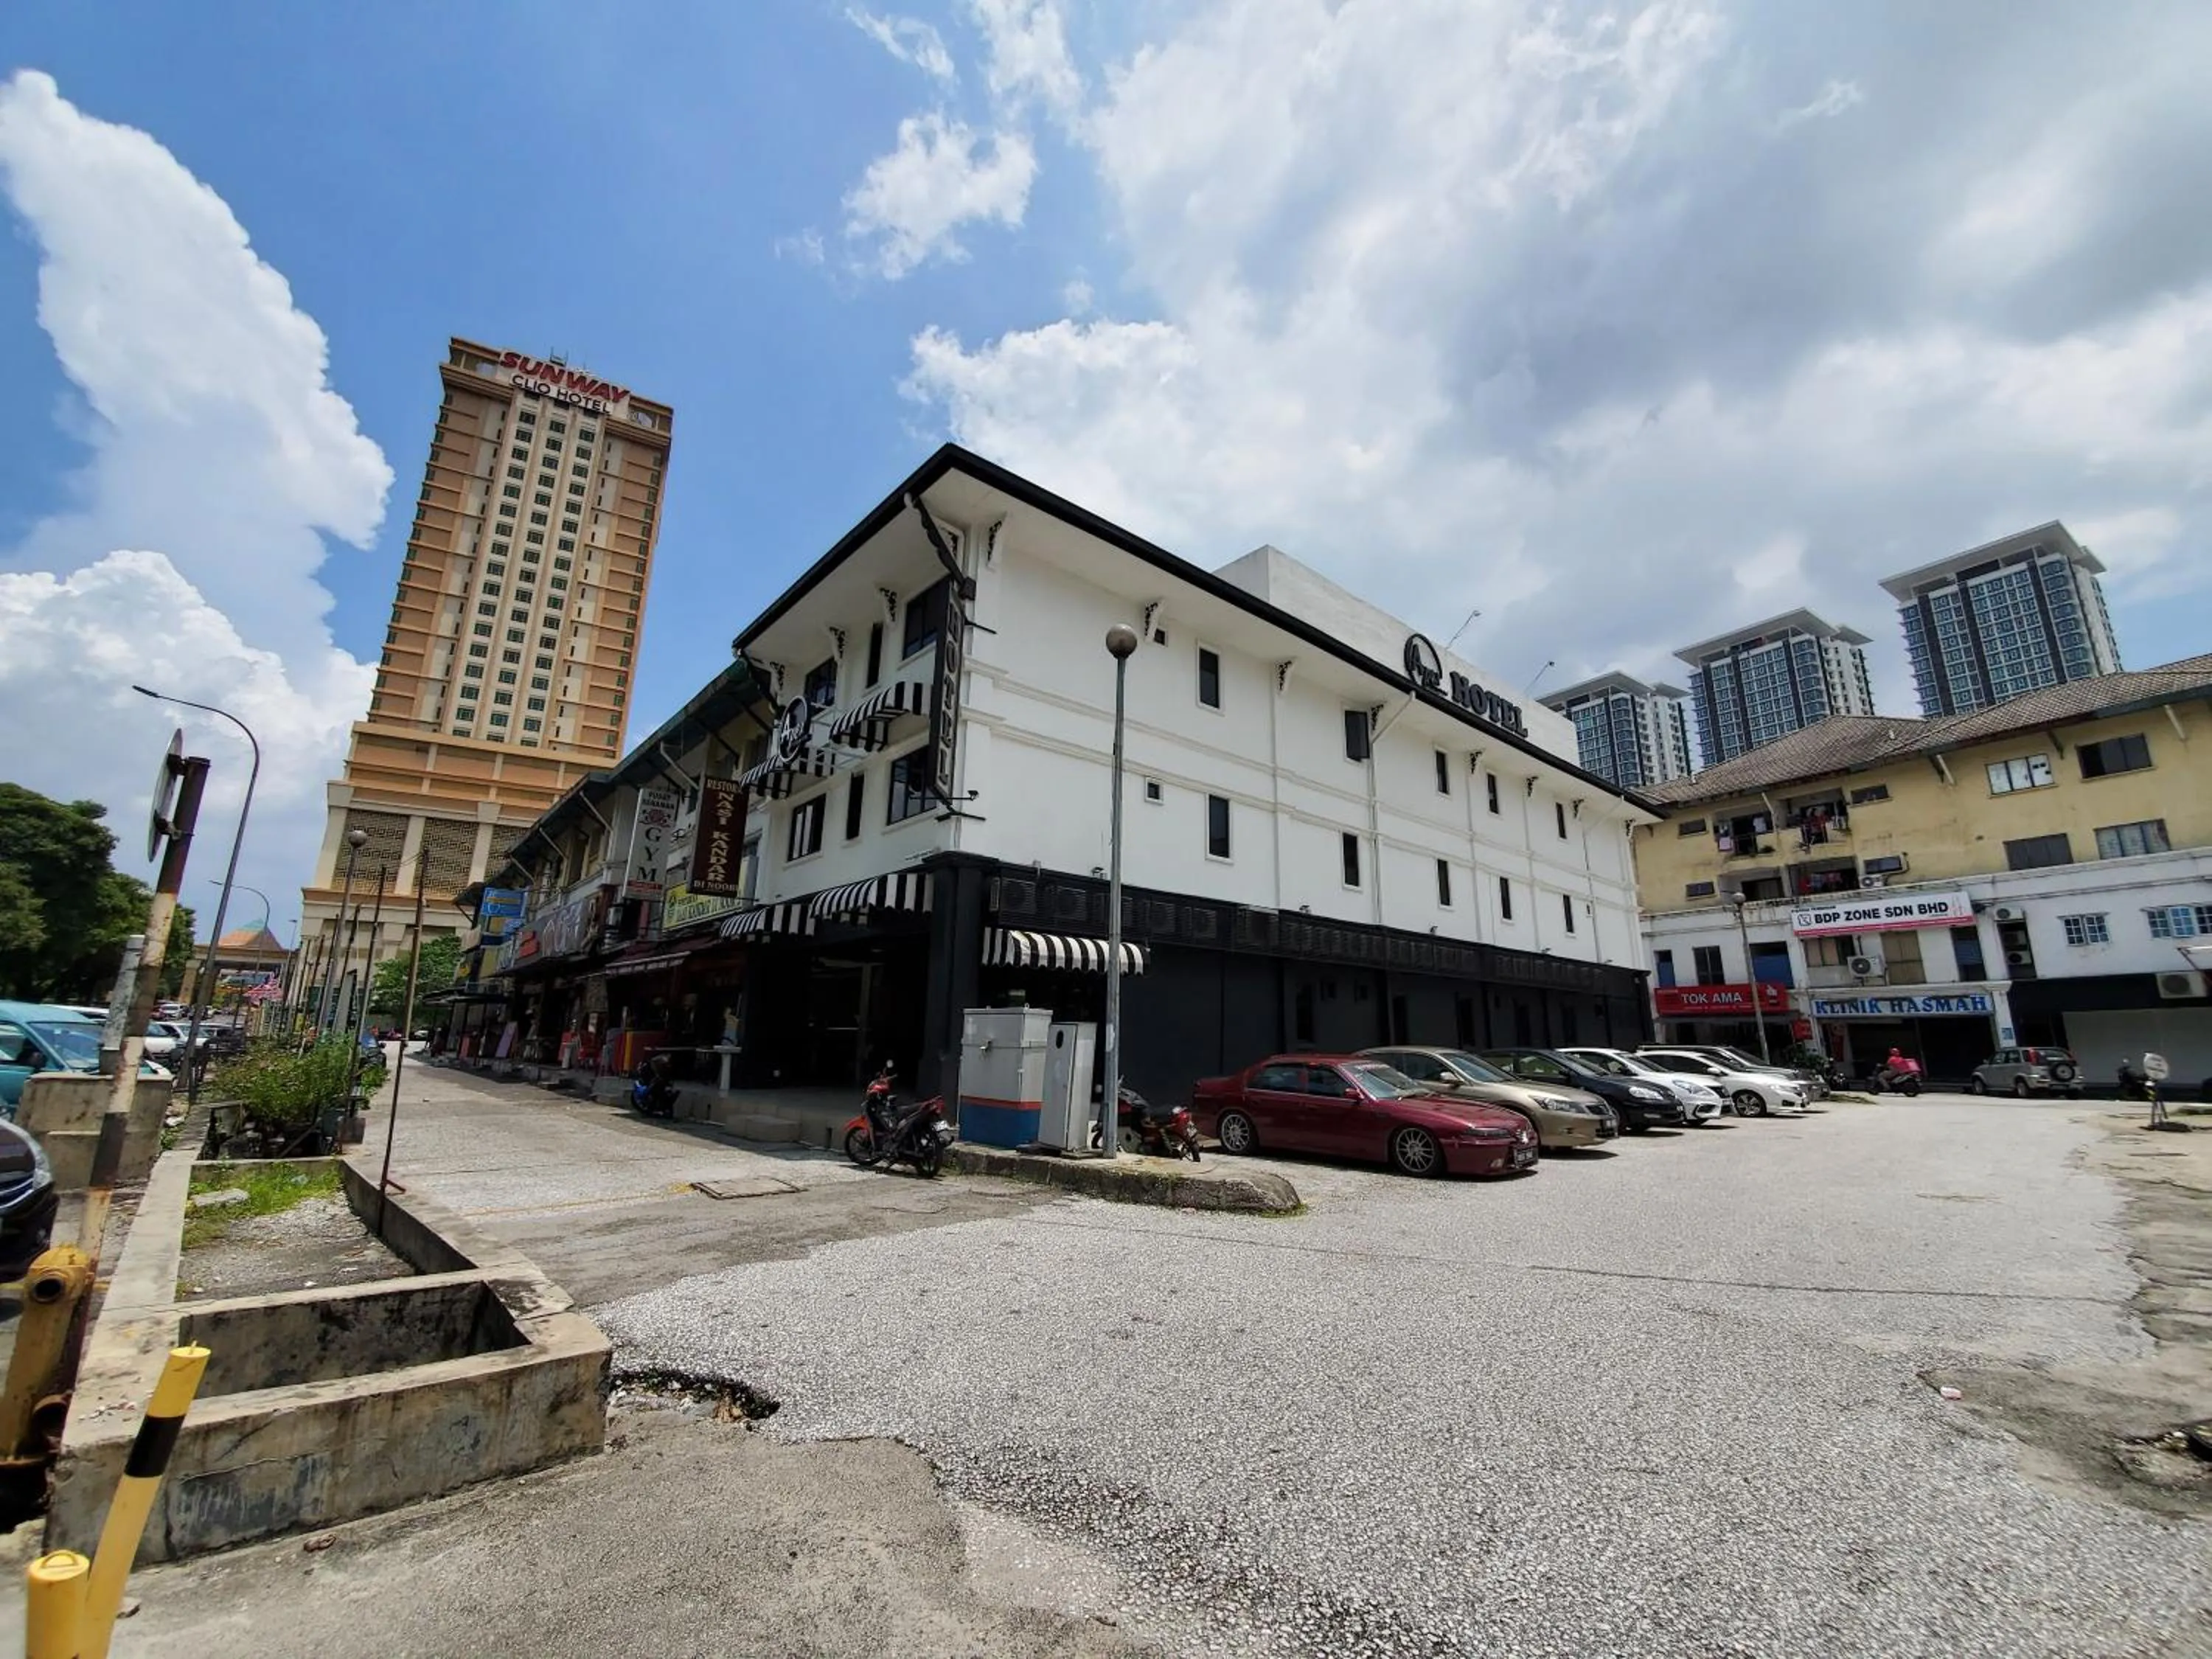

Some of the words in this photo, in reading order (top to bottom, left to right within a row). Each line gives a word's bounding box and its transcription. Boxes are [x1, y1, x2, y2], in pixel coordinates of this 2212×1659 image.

[499, 350, 630, 403] SUNWAY
[511, 375, 551, 395] CLIO
[557, 387, 611, 414] HOTEL
[939, 603, 959, 785] HOTEL
[1450, 670, 1528, 738] HOTEL
[707, 779, 742, 794] RESTOR
[716, 791, 735, 825] NASI
[638, 827, 662, 882] GYM
[707, 831, 731, 882] KANDAR
[1814, 911, 1840, 924] BDP
[1844, 908, 1881, 922] ZONE
[1884, 905, 1913, 919] SDN
[1918, 901, 1949, 915] BHD
[1681, 993, 1708, 1004] TOK
[1712, 992, 1743, 1004] AMA
[1815, 998, 1882, 1015] KLINIK
[1890, 994, 1987, 1013] HASMAH
